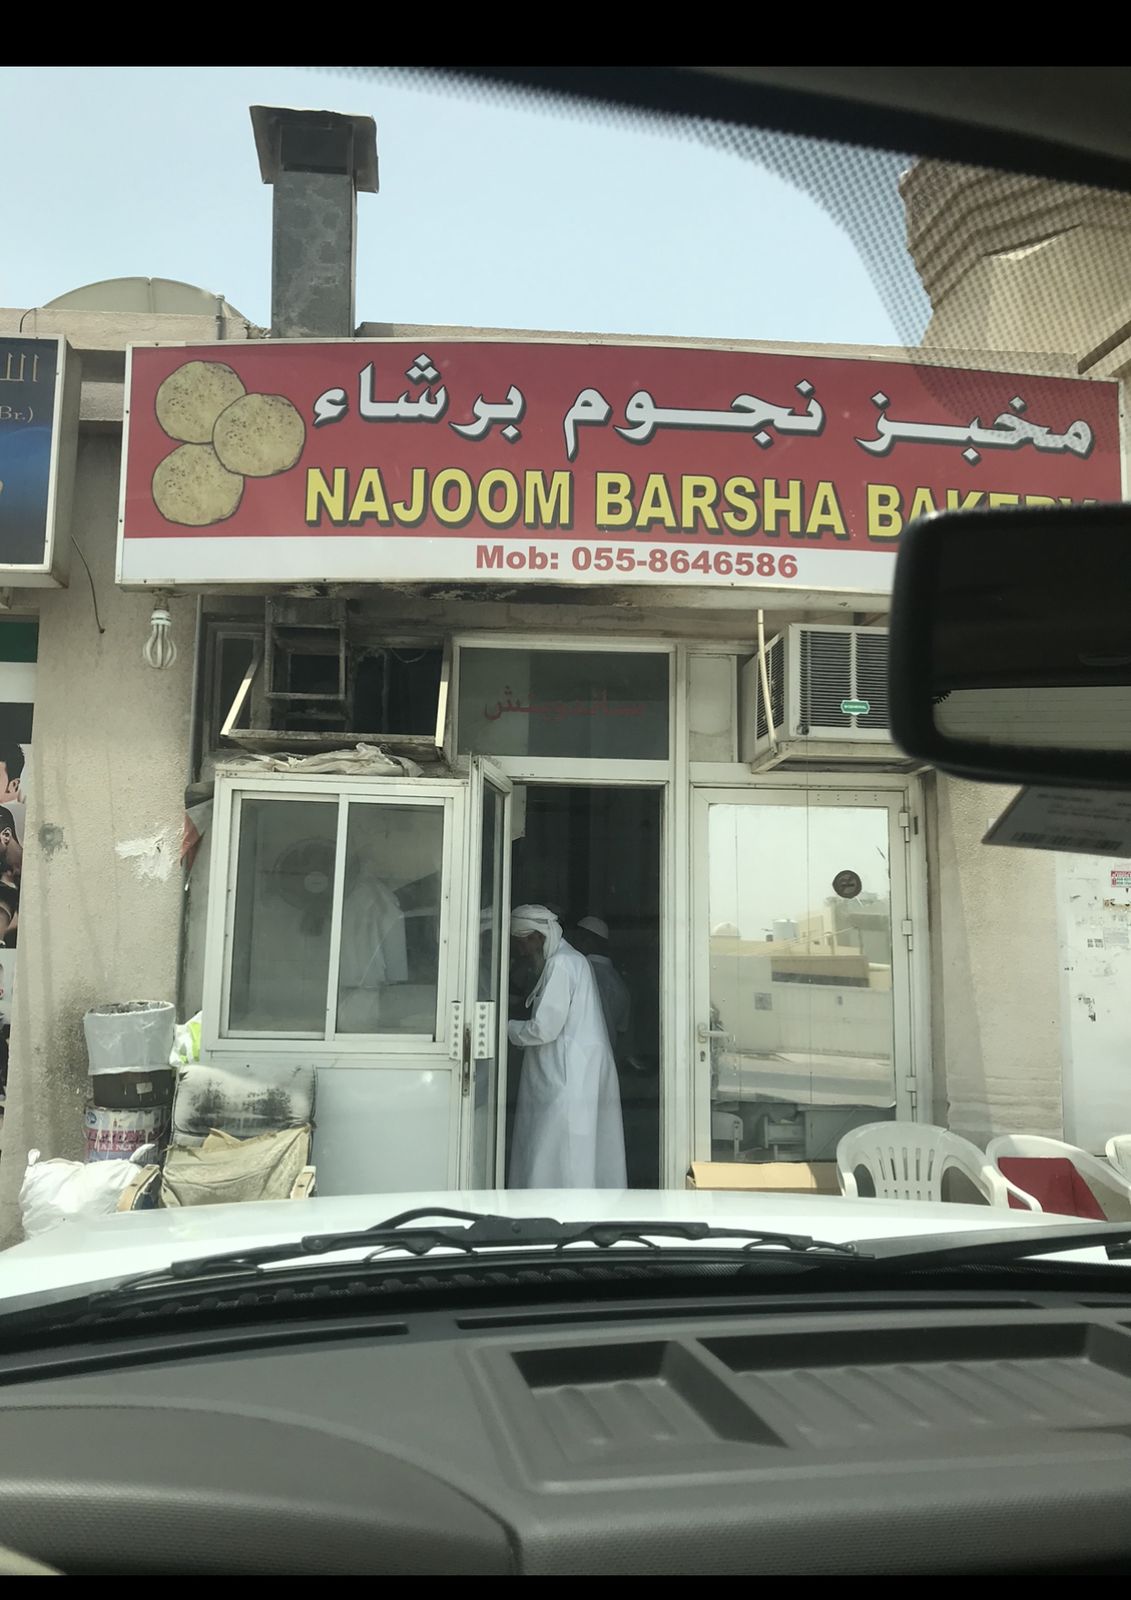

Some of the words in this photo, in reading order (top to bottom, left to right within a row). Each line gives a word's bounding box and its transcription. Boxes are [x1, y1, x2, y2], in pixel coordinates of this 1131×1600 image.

[312, 353, 526, 443] برشاء
[562, 379, 827, 462] نجوم
[854, 391, 1095, 465] مخبز
[305, 467, 573, 528] NAJOOM
[595, 471, 849, 538] BARSHA
[476, 545, 559, 570] Mob:
[571, 546, 799, 579] 055-8646586
